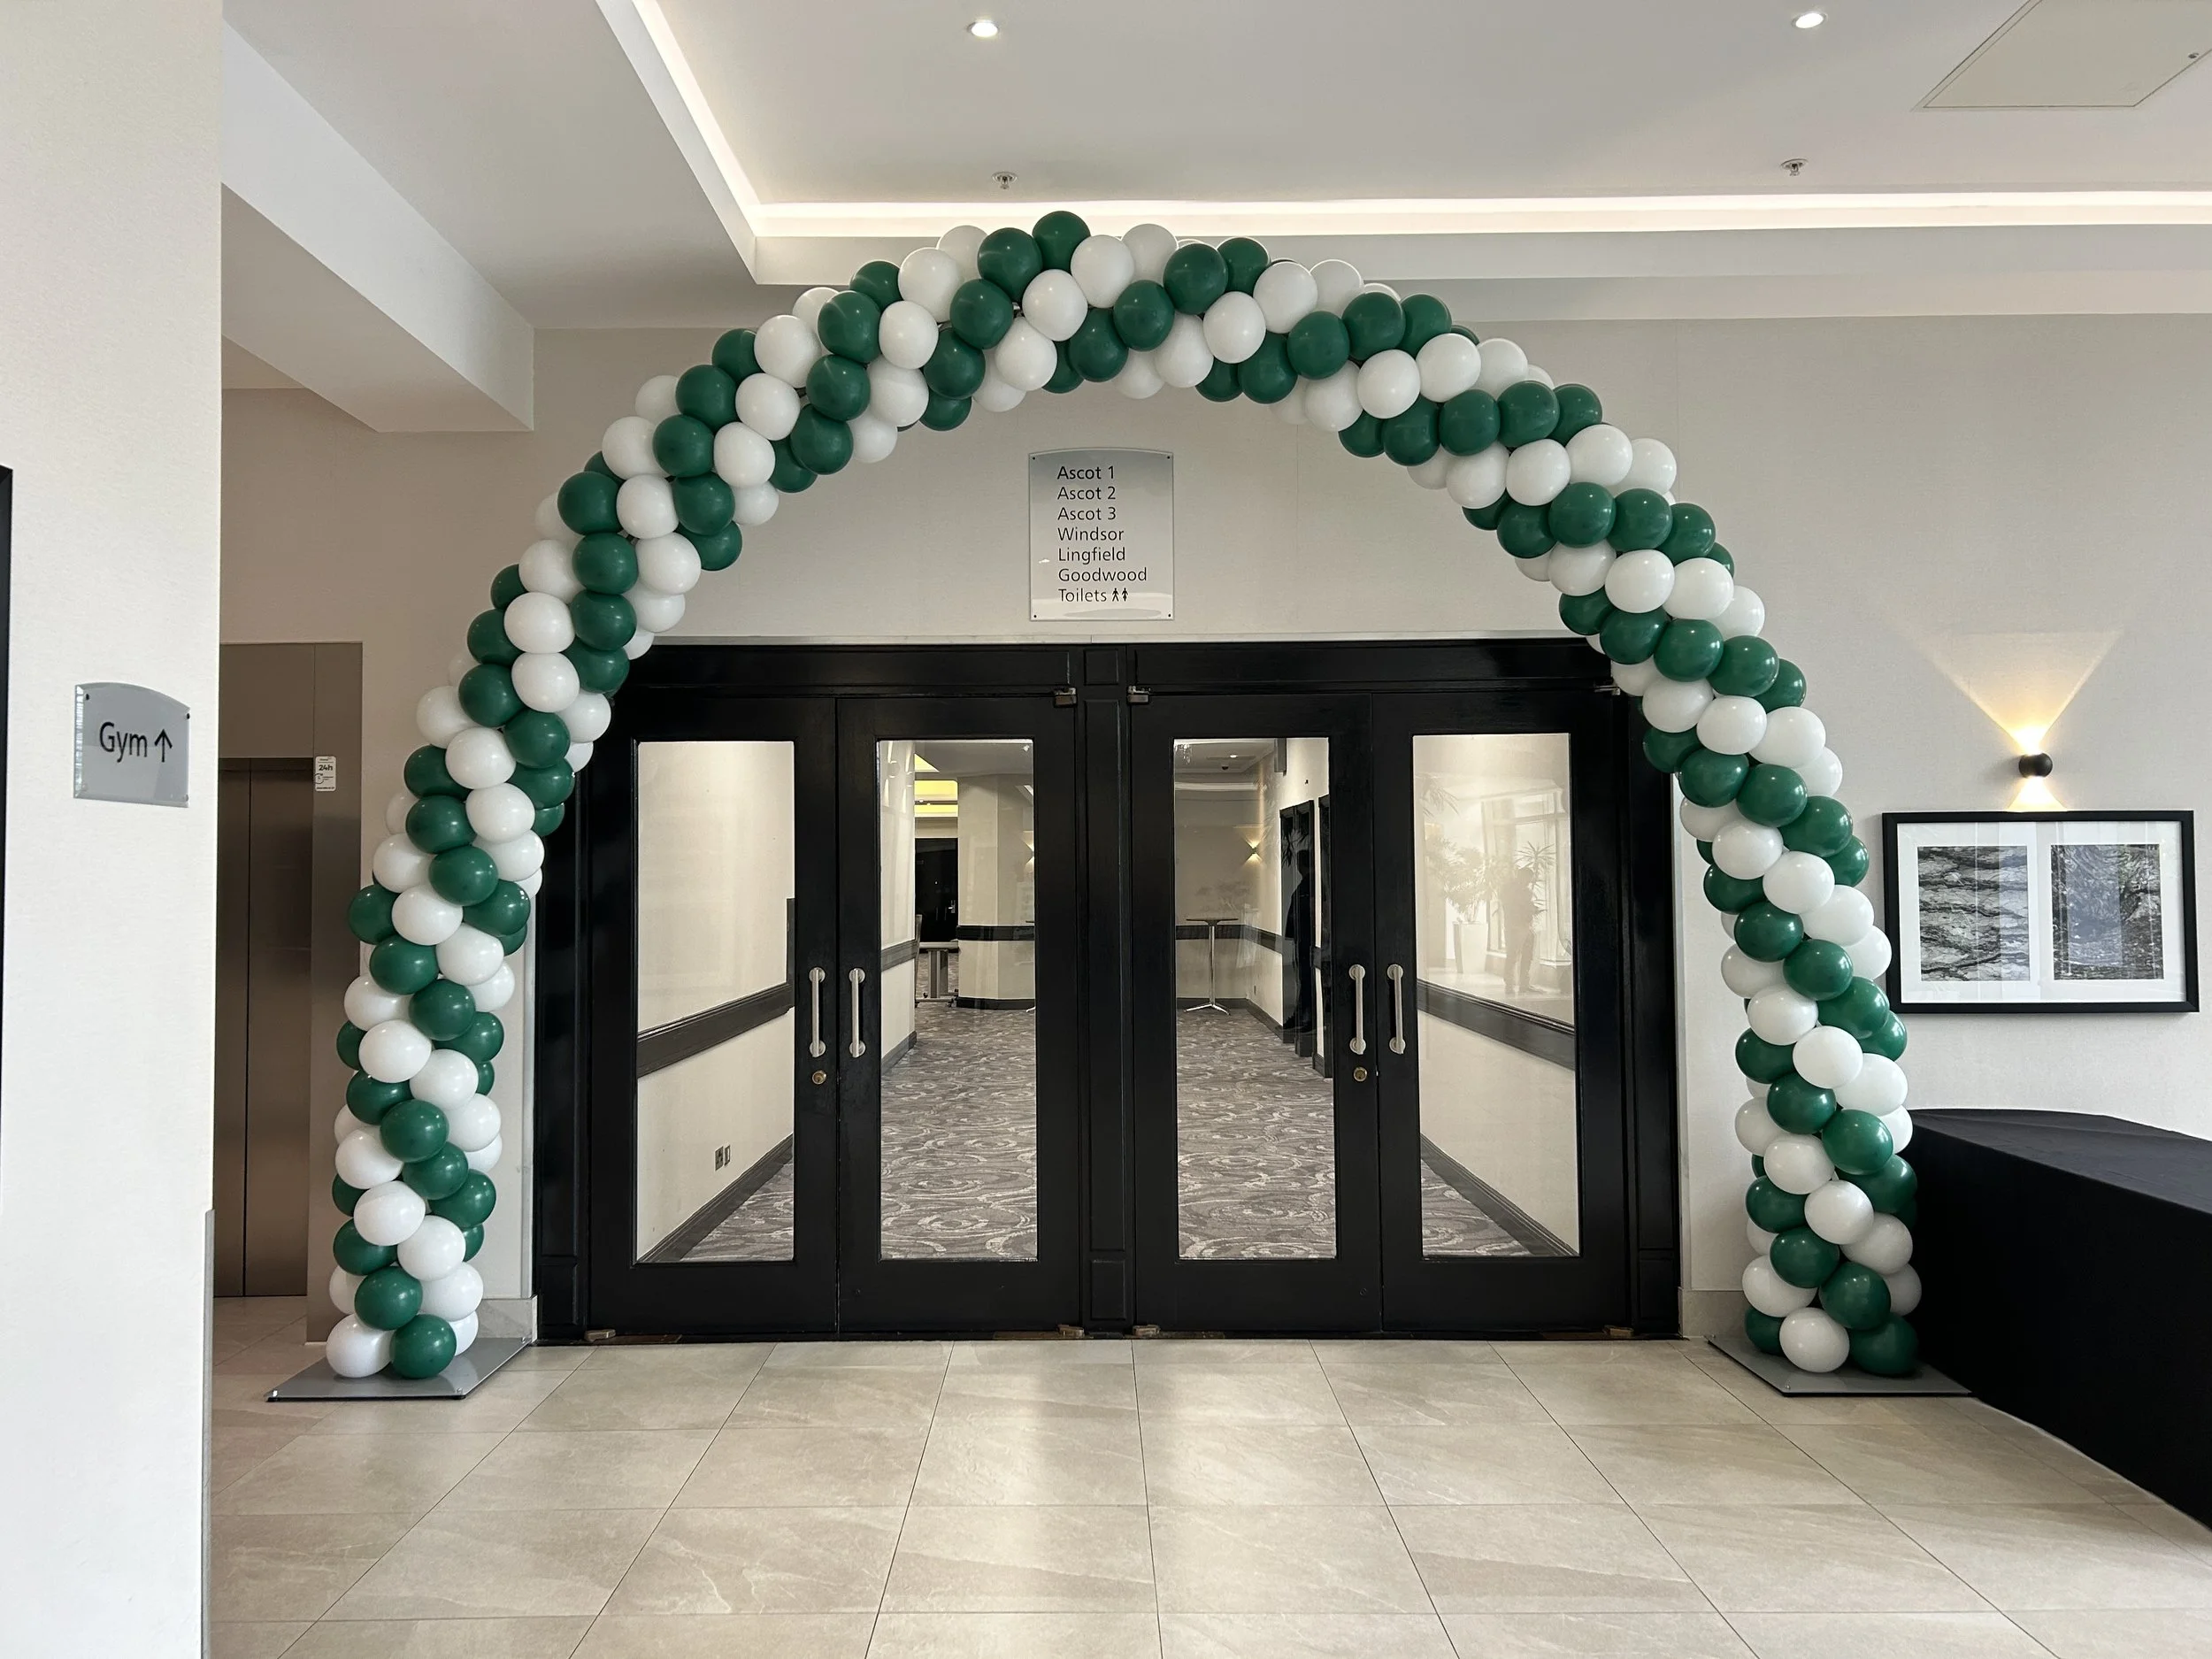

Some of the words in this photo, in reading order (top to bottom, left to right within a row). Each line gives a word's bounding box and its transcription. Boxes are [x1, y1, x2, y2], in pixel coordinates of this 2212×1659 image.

[1056, 465, 1102, 480] Ascot
[1108, 465, 1114, 480] 1
[1056, 486, 1102, 500] Ascot
[1107, 486, 1117, 500] 2
[1056, 506, 1102, 520] Ascot
[1107, 506, 1118, 520] 3
[1056, 526, 1125, 541] Windsor
[1057, 546, 1125, 565] Lingfield
[1057, 567, 1148, 582] Goodwood
[1057, 588, 1108, 603] Toilets
[99, 721, 148, 763] Gym
